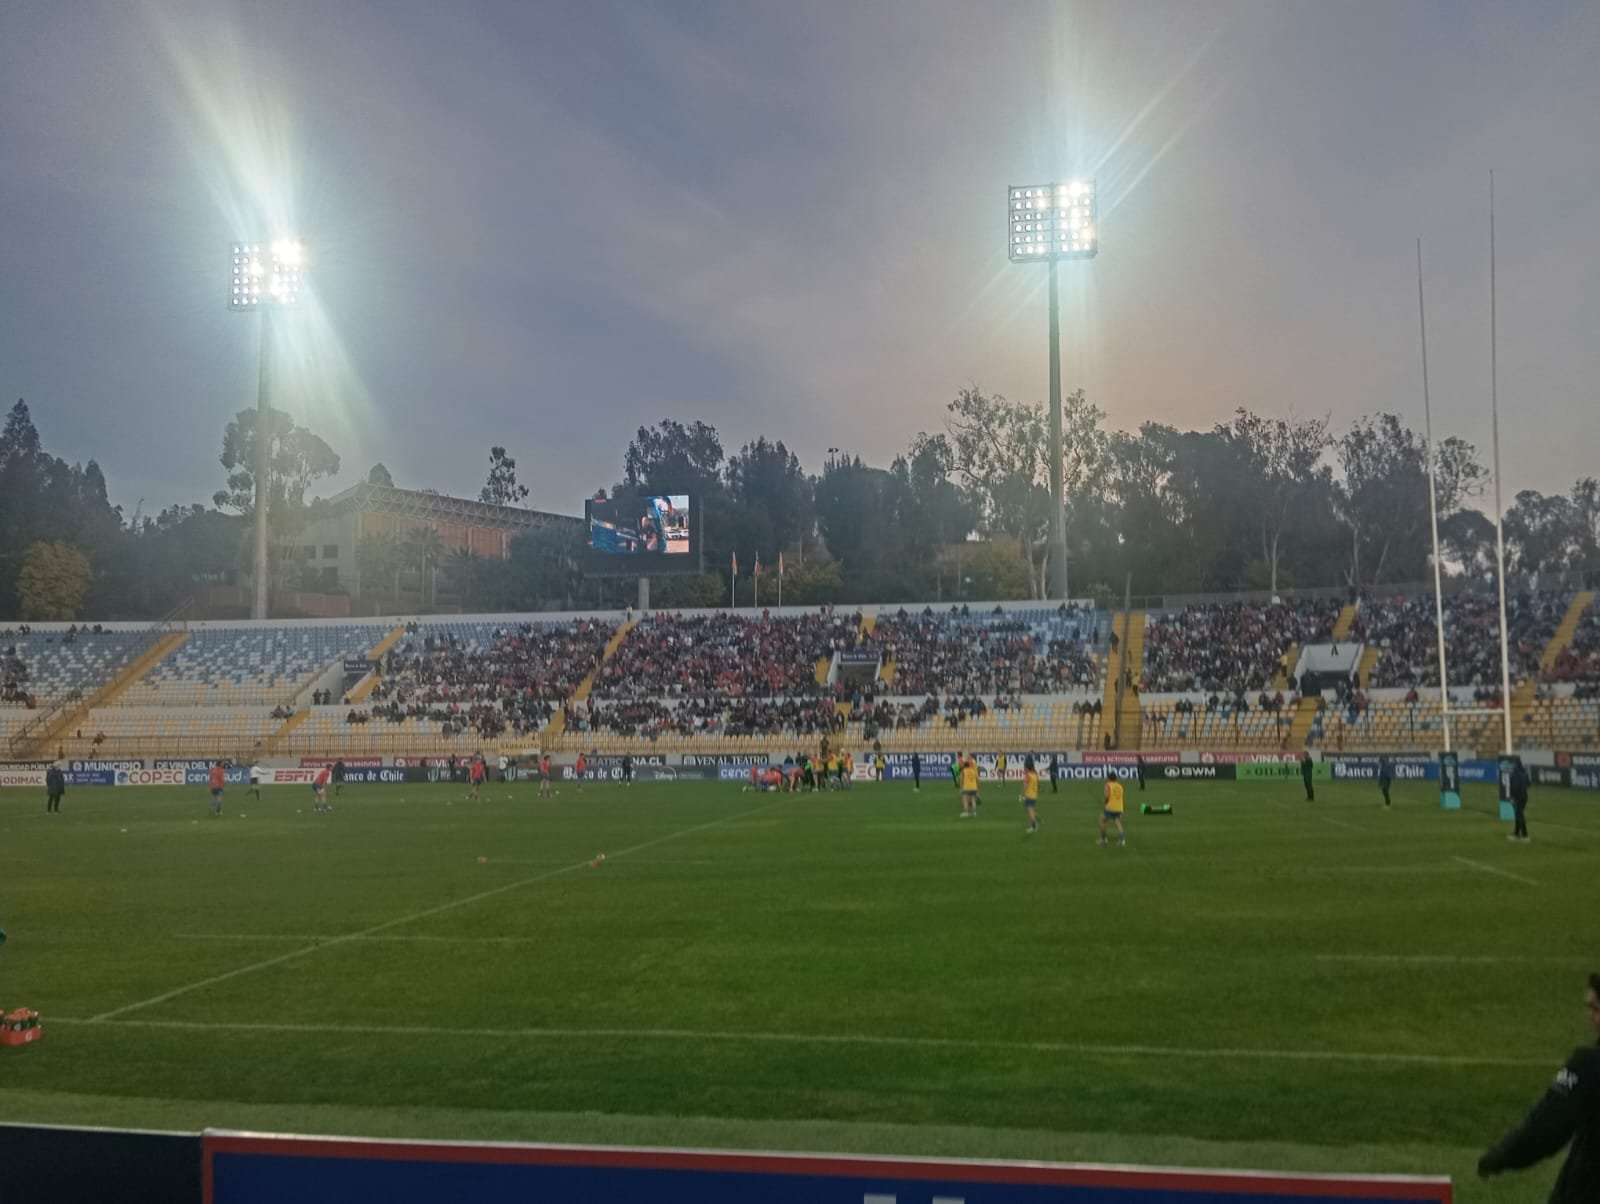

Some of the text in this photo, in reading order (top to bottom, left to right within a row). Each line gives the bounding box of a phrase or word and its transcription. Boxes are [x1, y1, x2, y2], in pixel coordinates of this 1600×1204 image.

[1331, 645, 1338, 656] A
[84, 761, 141, 771] MUNICIPIO
[156, 761, 168, 769] DE
[191, 761, 208, 769] DEL
[696, 756, 768, 765] VEN AL TEATRO
[274, 770, 315, 781] ESPN
[367, 769, 377, 781] de
[379, 768, 405, 782] Chile
[1058, 764, 1138, 778] marathon
[1181, 766, 1215, 776] GWM
[1334, 763, 1373, 777] Banco
[1395, 764, 1424, 777] Chile
[129, 771, 183, 784] COPEC
